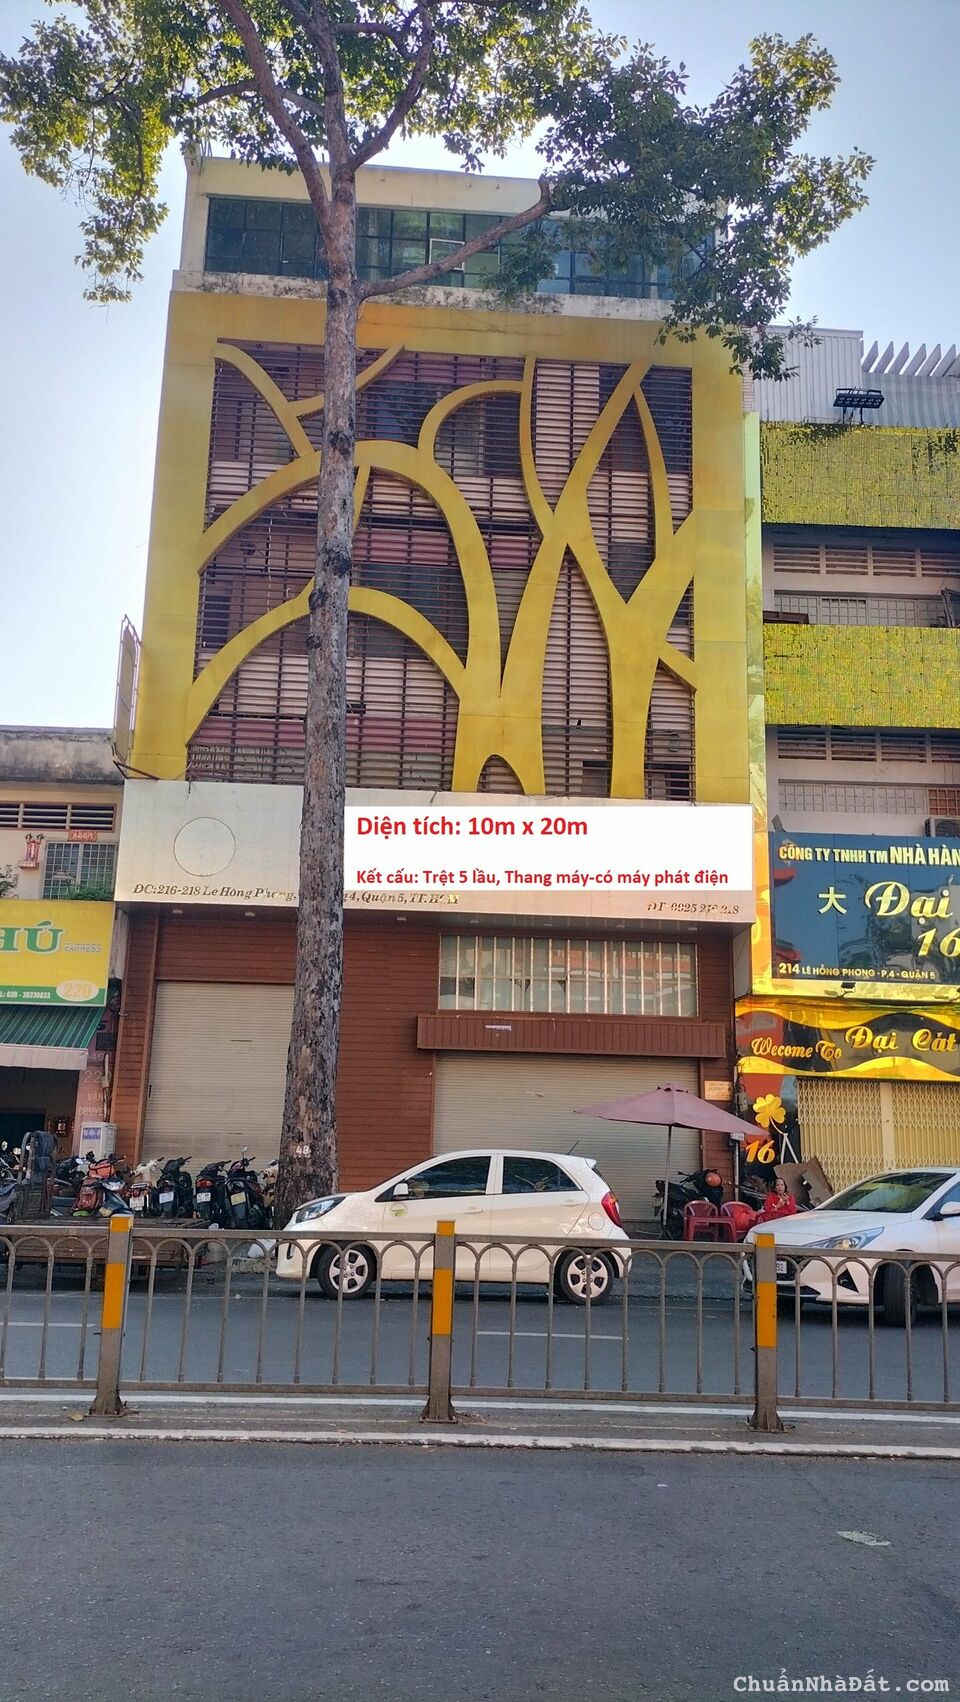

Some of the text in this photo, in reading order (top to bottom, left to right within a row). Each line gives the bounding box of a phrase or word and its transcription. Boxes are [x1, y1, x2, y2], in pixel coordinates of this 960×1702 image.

[779, 843, 813, 861] CÔNG
[815, 848, 831, 862] TY
[833, 848, 867, 863] TNHH
[868, 850, 889, 864] TM
[889, 844, 927, 866] NHÀ
[818, 886, 847, 914] 大
[864, 881, 954, 925] Đại
[917, 929, 960, 957] 16
[778, 963, 800, 975] 214
[842, 967, 876, 977] PHONG
[881, 968, 895, 978] P.4
[929, 971, 936, 979] 5
[64, 984, 92, 998] 220
[750, 1037, 813, 1058] Wecome
[844, 1026, 899, 1053] Đại
[295, 1145, 310, 1155] 48
[745, 1140, 775, 1164] 16
